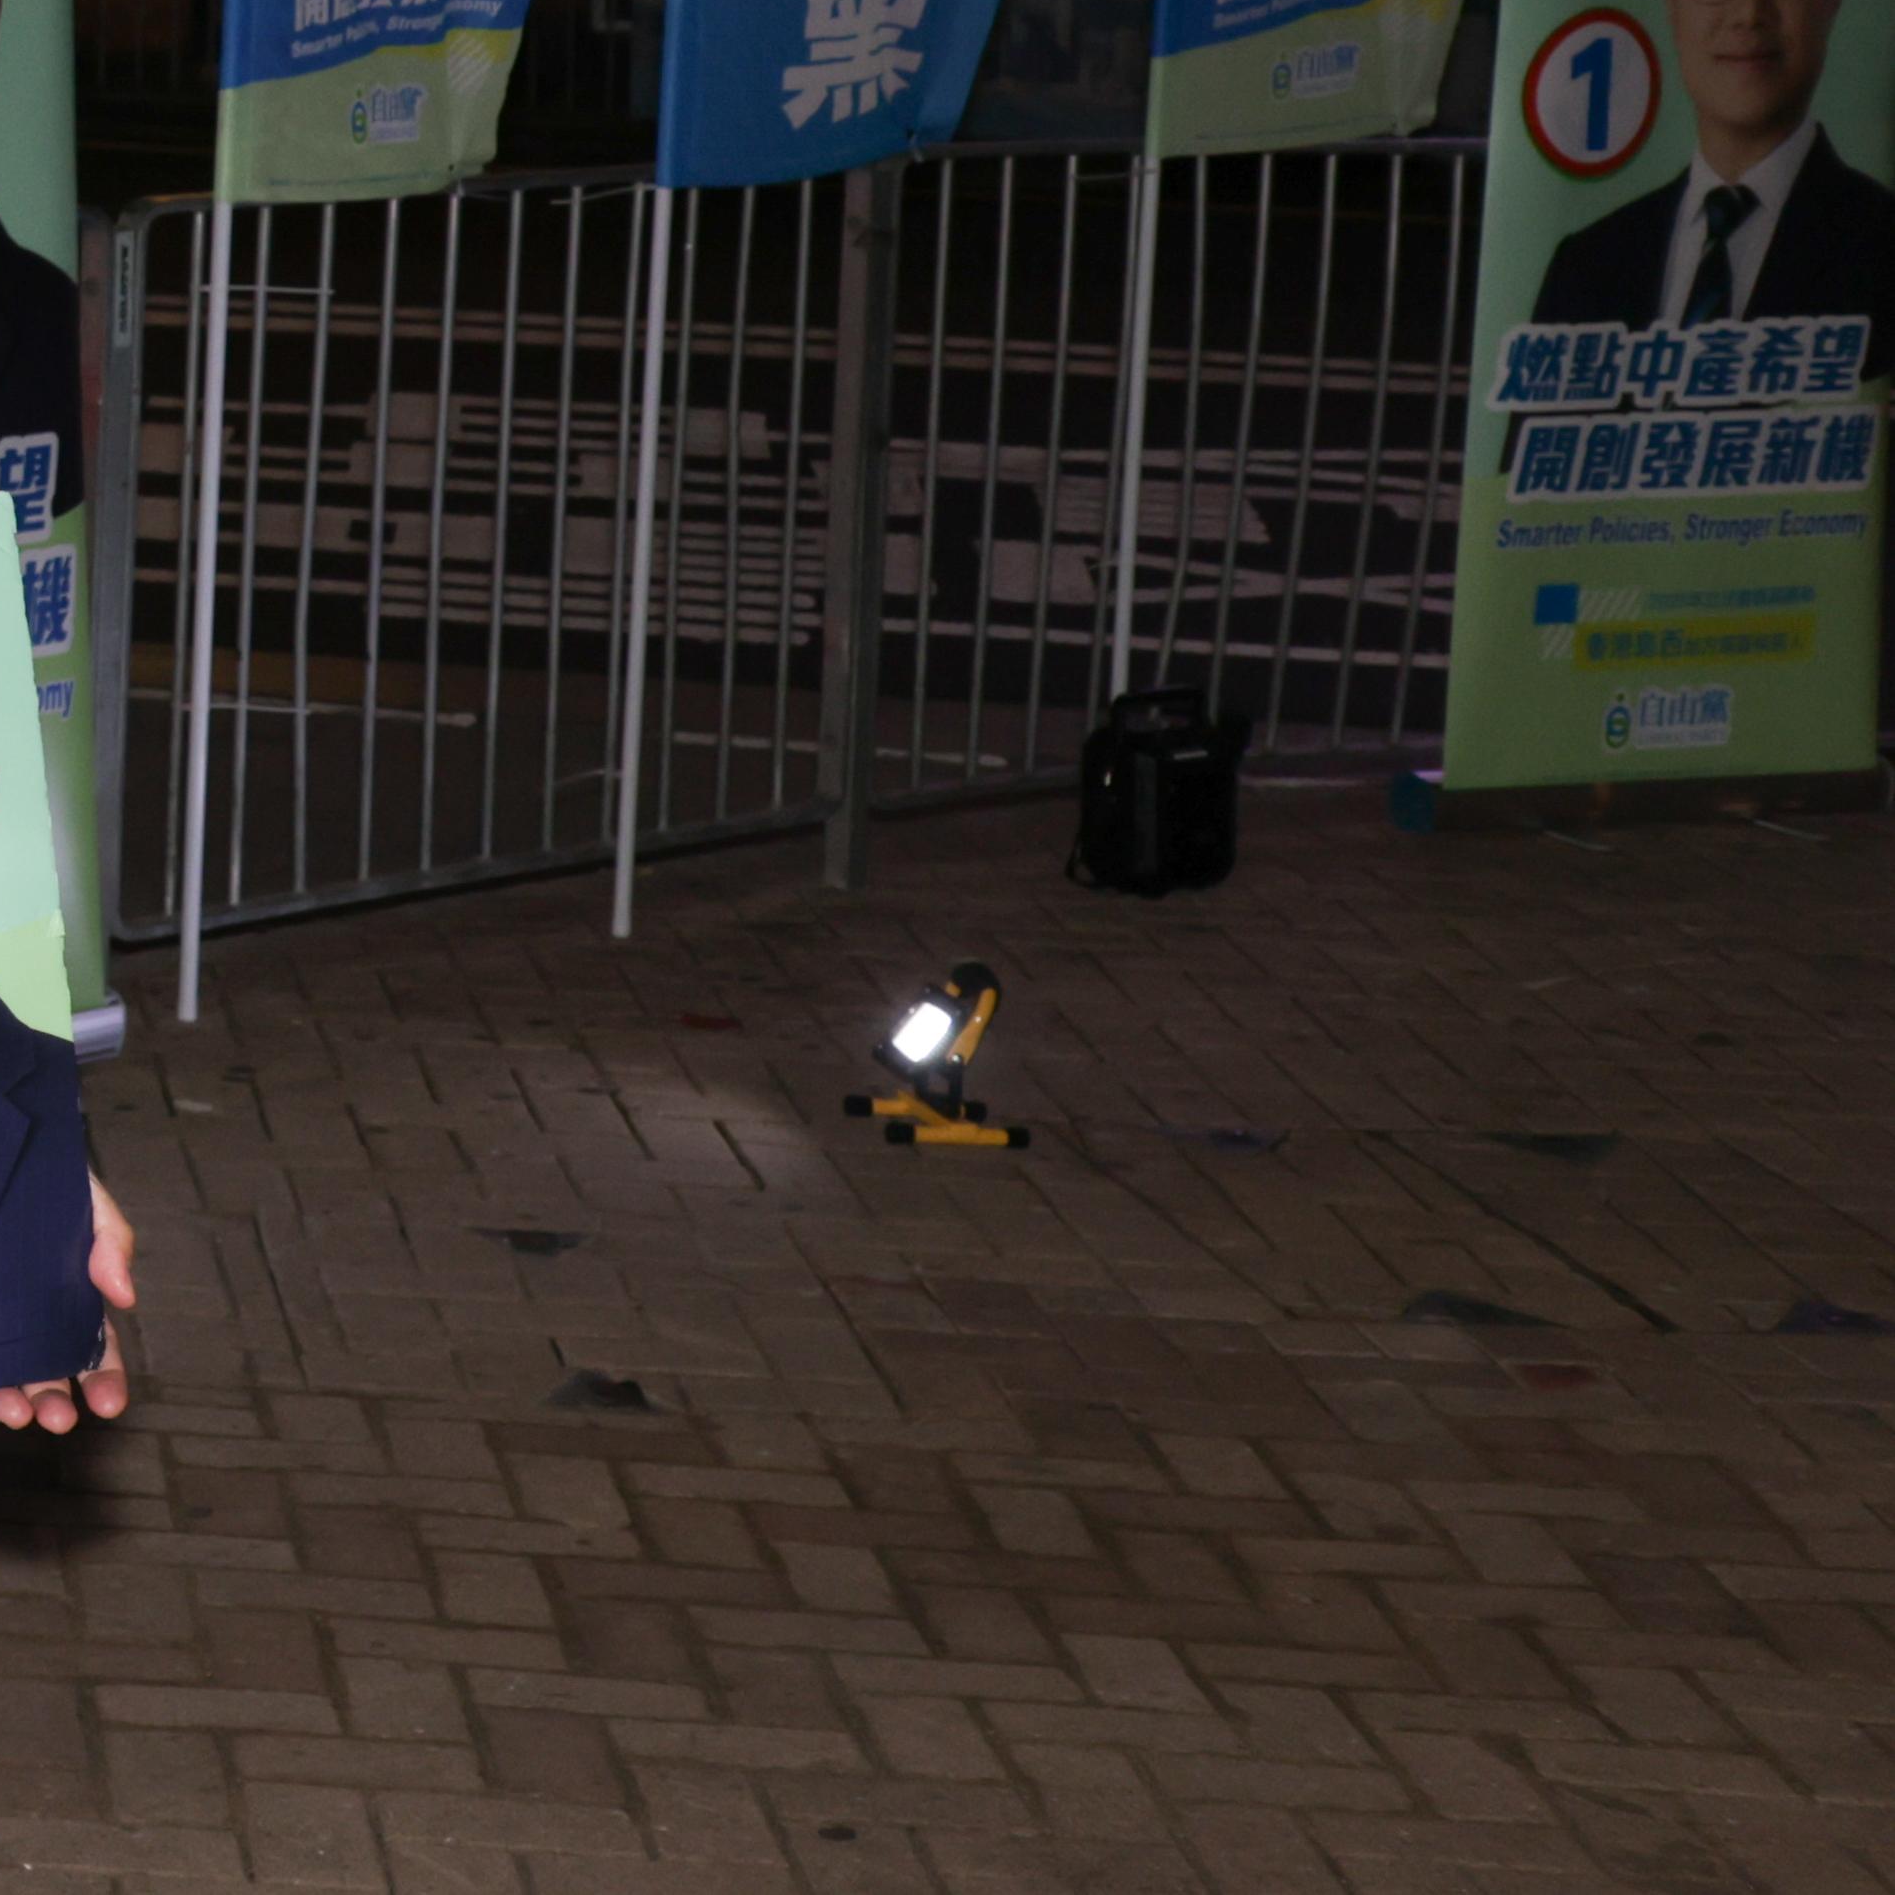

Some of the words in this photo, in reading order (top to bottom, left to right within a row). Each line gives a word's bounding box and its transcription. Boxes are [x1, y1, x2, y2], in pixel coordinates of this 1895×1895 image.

[1570, 37, 1614, 151] 1
[1496, 323, 1869, 404] 燃點中產希望
[1514, 414, 1876, 496] 開創發展新機
[1496, 518, 1582, 549] Smarter
[1684, 513, 1773, 546] Stronger
[1779, 509, 1868, 540] Economy
